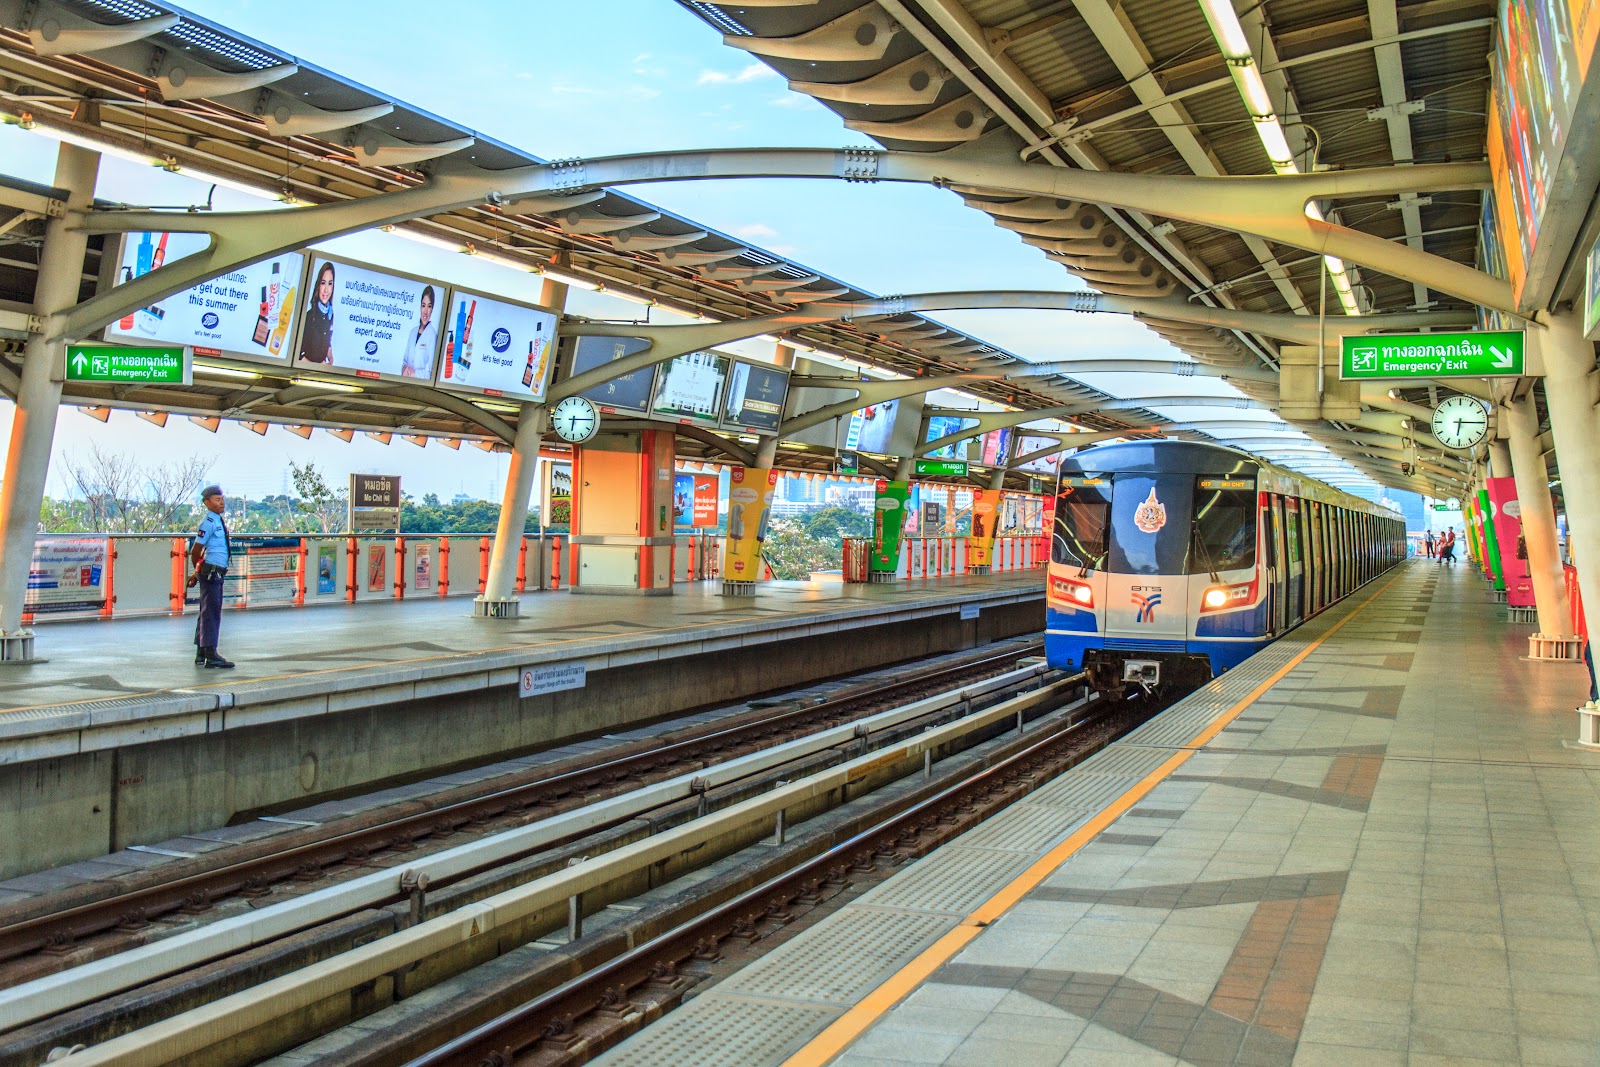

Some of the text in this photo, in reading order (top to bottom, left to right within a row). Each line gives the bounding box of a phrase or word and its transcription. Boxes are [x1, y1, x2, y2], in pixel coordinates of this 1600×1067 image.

[200, 283, 212, 294] get
[214, 286, 228, 296] out
[229, 288, 248, 300] there
[189, 294, 238, 312] this summer
[349, 312, 401, 330] exclusive products
[354, 326, 392, 340] expert advice
[1382, 340, 1483, 363] ทางออกฉุกเฉิน
[112, 354, 178, 371] ทางออกฉุกเฉิน
[482, 354, 513, 367] let's feel good
[1384, 360, 1468, 372] Emergency Exit
[112, 368, 167, 378] Emergency Exit
[364, 476, 390, 490] หมอชิต
